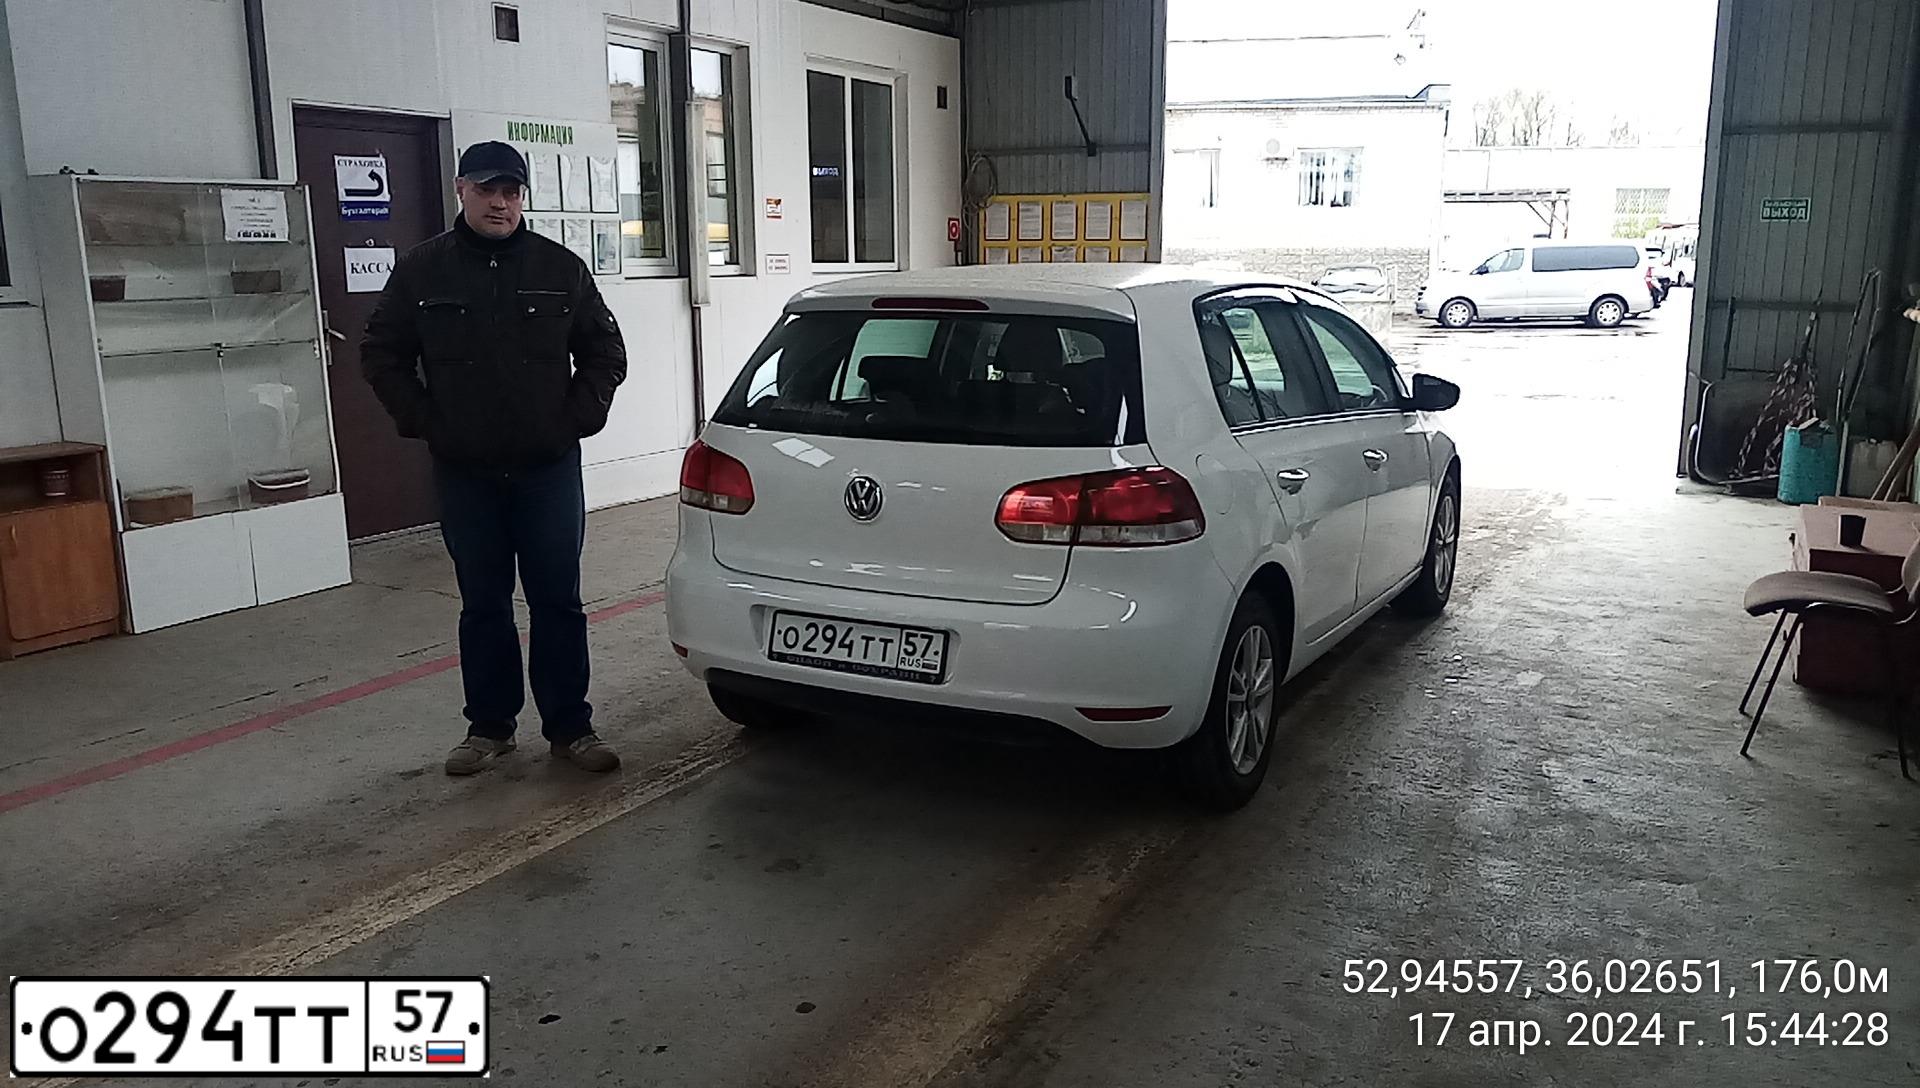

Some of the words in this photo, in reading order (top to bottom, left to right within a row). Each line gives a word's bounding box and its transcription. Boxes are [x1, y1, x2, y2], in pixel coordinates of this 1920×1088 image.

[506, 120, 575, 148] ИНФОРМАЦИЯ
[1762, 207, 1807, 220] ВЫХОД
[350, 262, 394, 275] КАССА
[902, 630, 934, 659] 57
[900, 656, 922, 668] RUS
